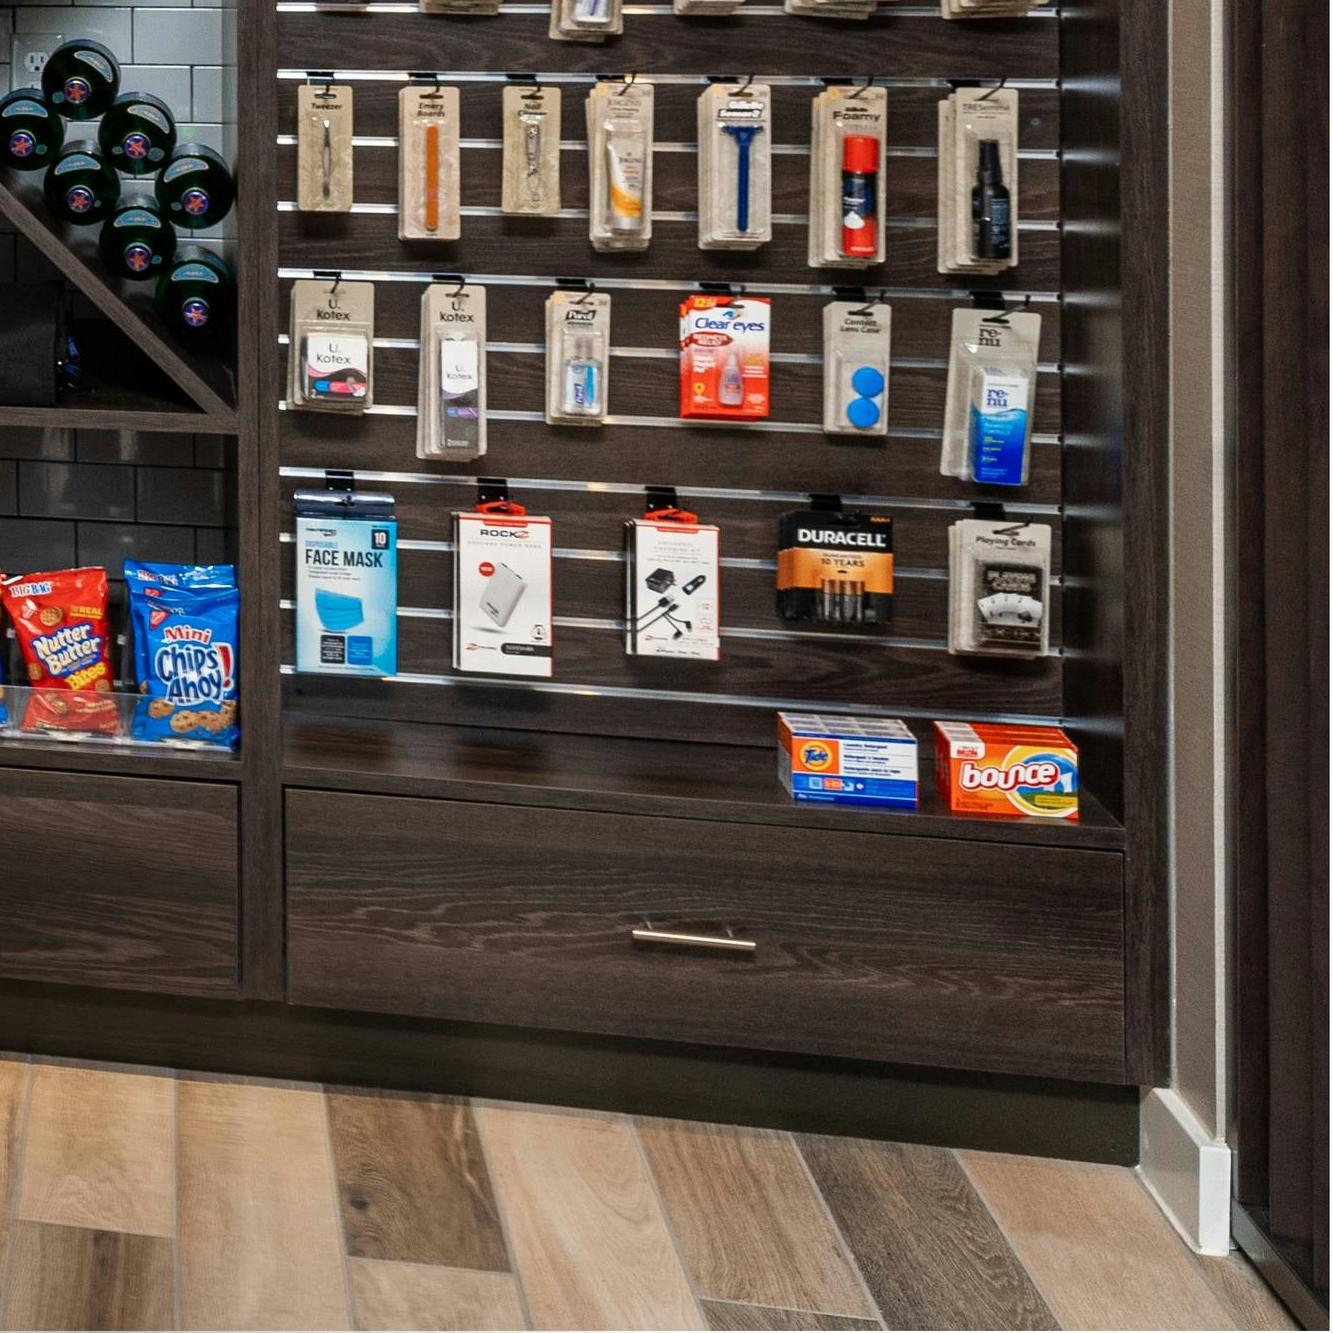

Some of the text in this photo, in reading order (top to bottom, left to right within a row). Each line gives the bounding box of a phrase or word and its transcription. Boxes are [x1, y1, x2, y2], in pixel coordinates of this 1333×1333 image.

[833, 111, 881, 122] Foamy
[694, 317, 765, 334] Clear eyes
[374, 531, 387, 544] 10
[797, 528, 886, 548] DURACELL
[975, 535, 1036, 548] Playing Cards
[305, 548, 383, 568] FACE MASK
[831, 558, 865, 568] YEARS
[32, 624, 91, 656] Nutter
[163, 625, 212, 644] Mini
[45, 637, 101, 675] Butter
[157, 645, 218, 679] Chips
[65, 662, 106, 690] Bites
[803, 748, 829, 764] Tide
[962, 762, 1059, 791] bounce
